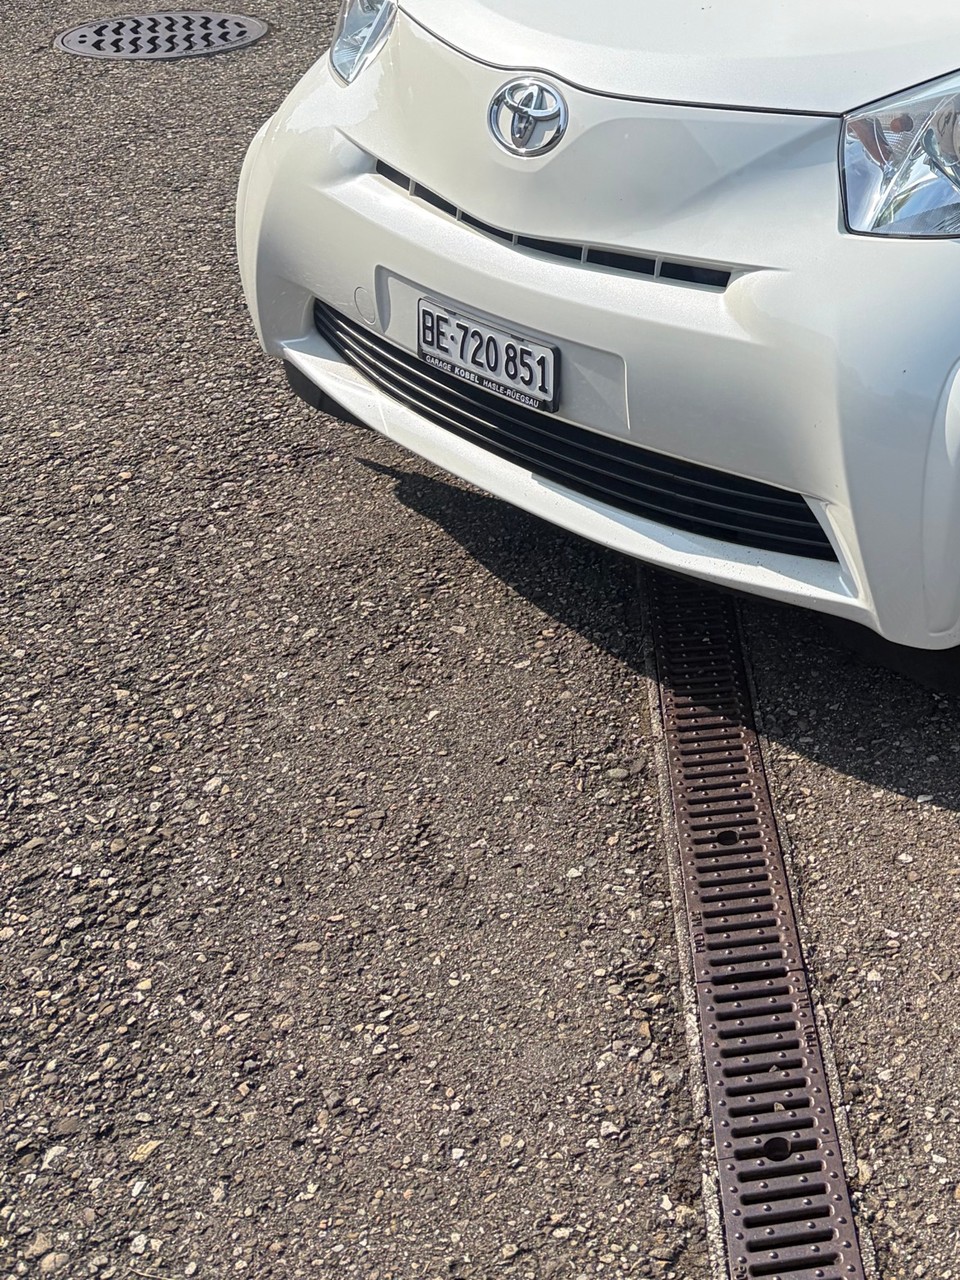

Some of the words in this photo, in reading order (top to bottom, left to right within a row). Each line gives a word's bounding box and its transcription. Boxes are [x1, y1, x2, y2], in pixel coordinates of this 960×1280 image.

[425, 354, 452, 372] GARAGE
[454, 365, 480, 384] KOBEL
[482, 378, 540, 408] HASLE-RÜEGSAU
[504, 342, 548, 394] 851
